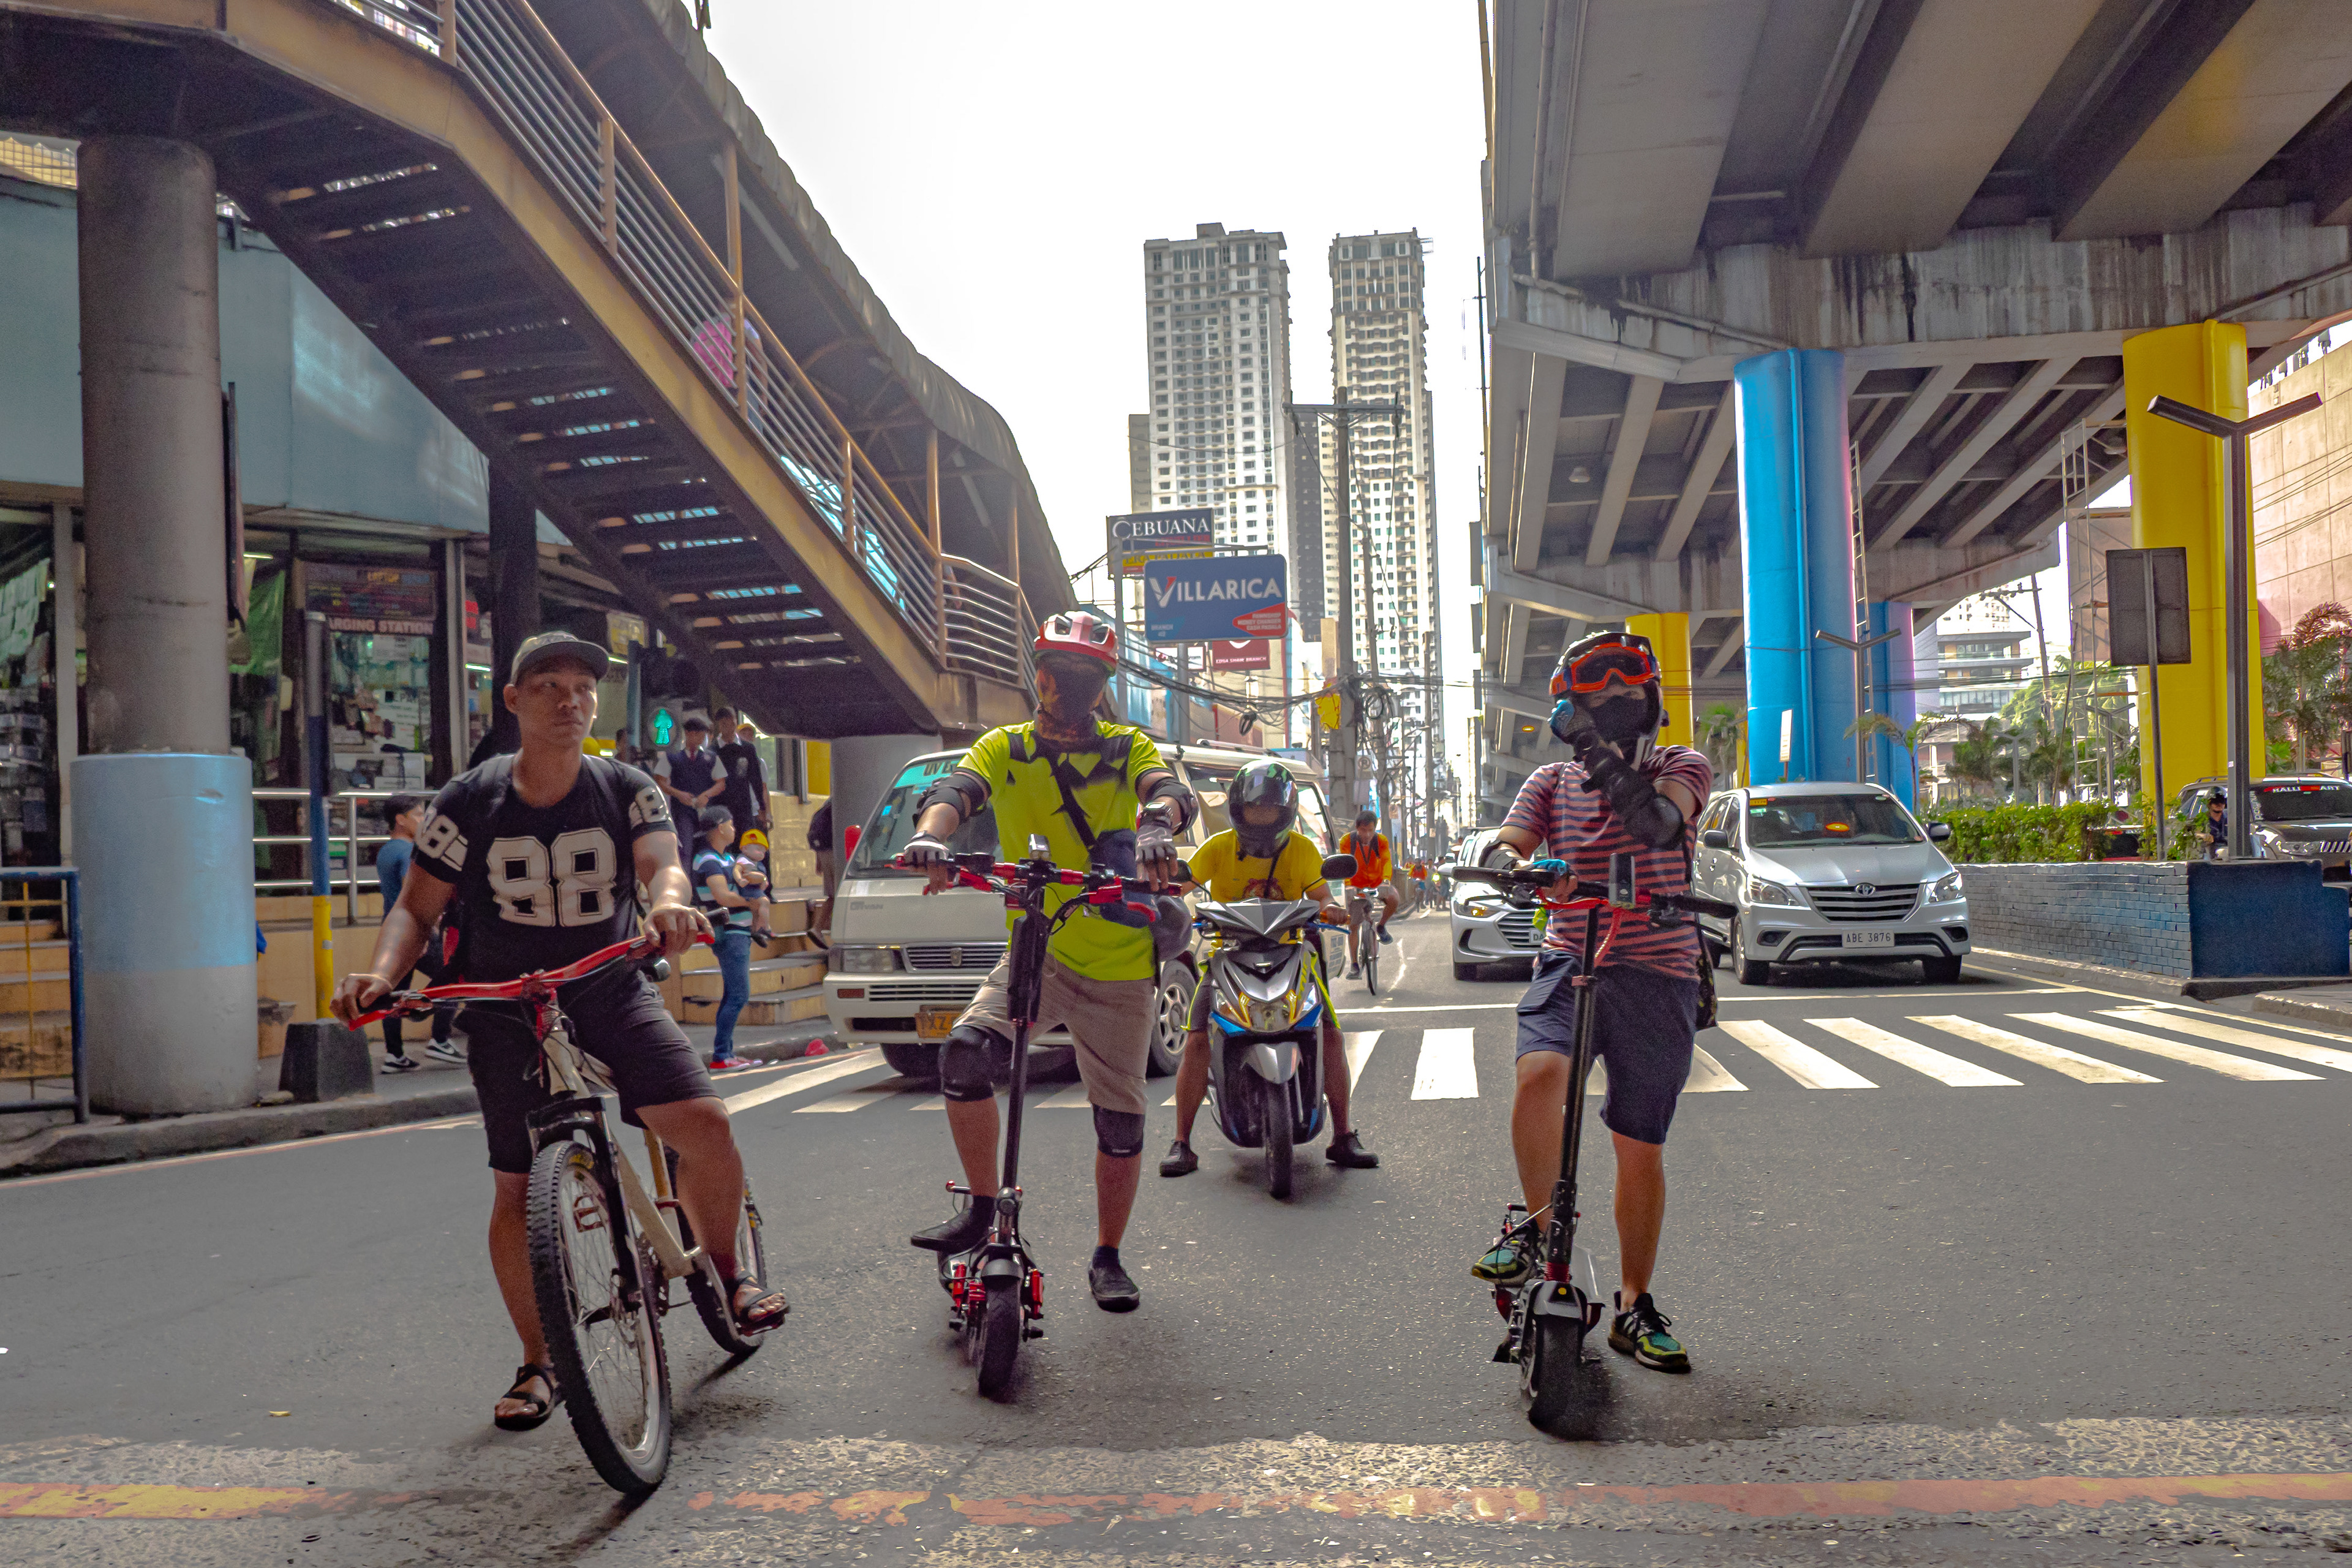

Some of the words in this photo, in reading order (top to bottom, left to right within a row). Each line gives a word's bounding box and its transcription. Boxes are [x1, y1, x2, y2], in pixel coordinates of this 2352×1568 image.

[1112, 517, 1211, 540] CEBUANA
[1148, 576, 1283, 608] VILLARICA
[378, 620, 433, 635] STATION
[486, 827, 617, 928] 98
[1846, 933, 1863, 943] ABE
[1868, 932, 1891, 943] 3876
